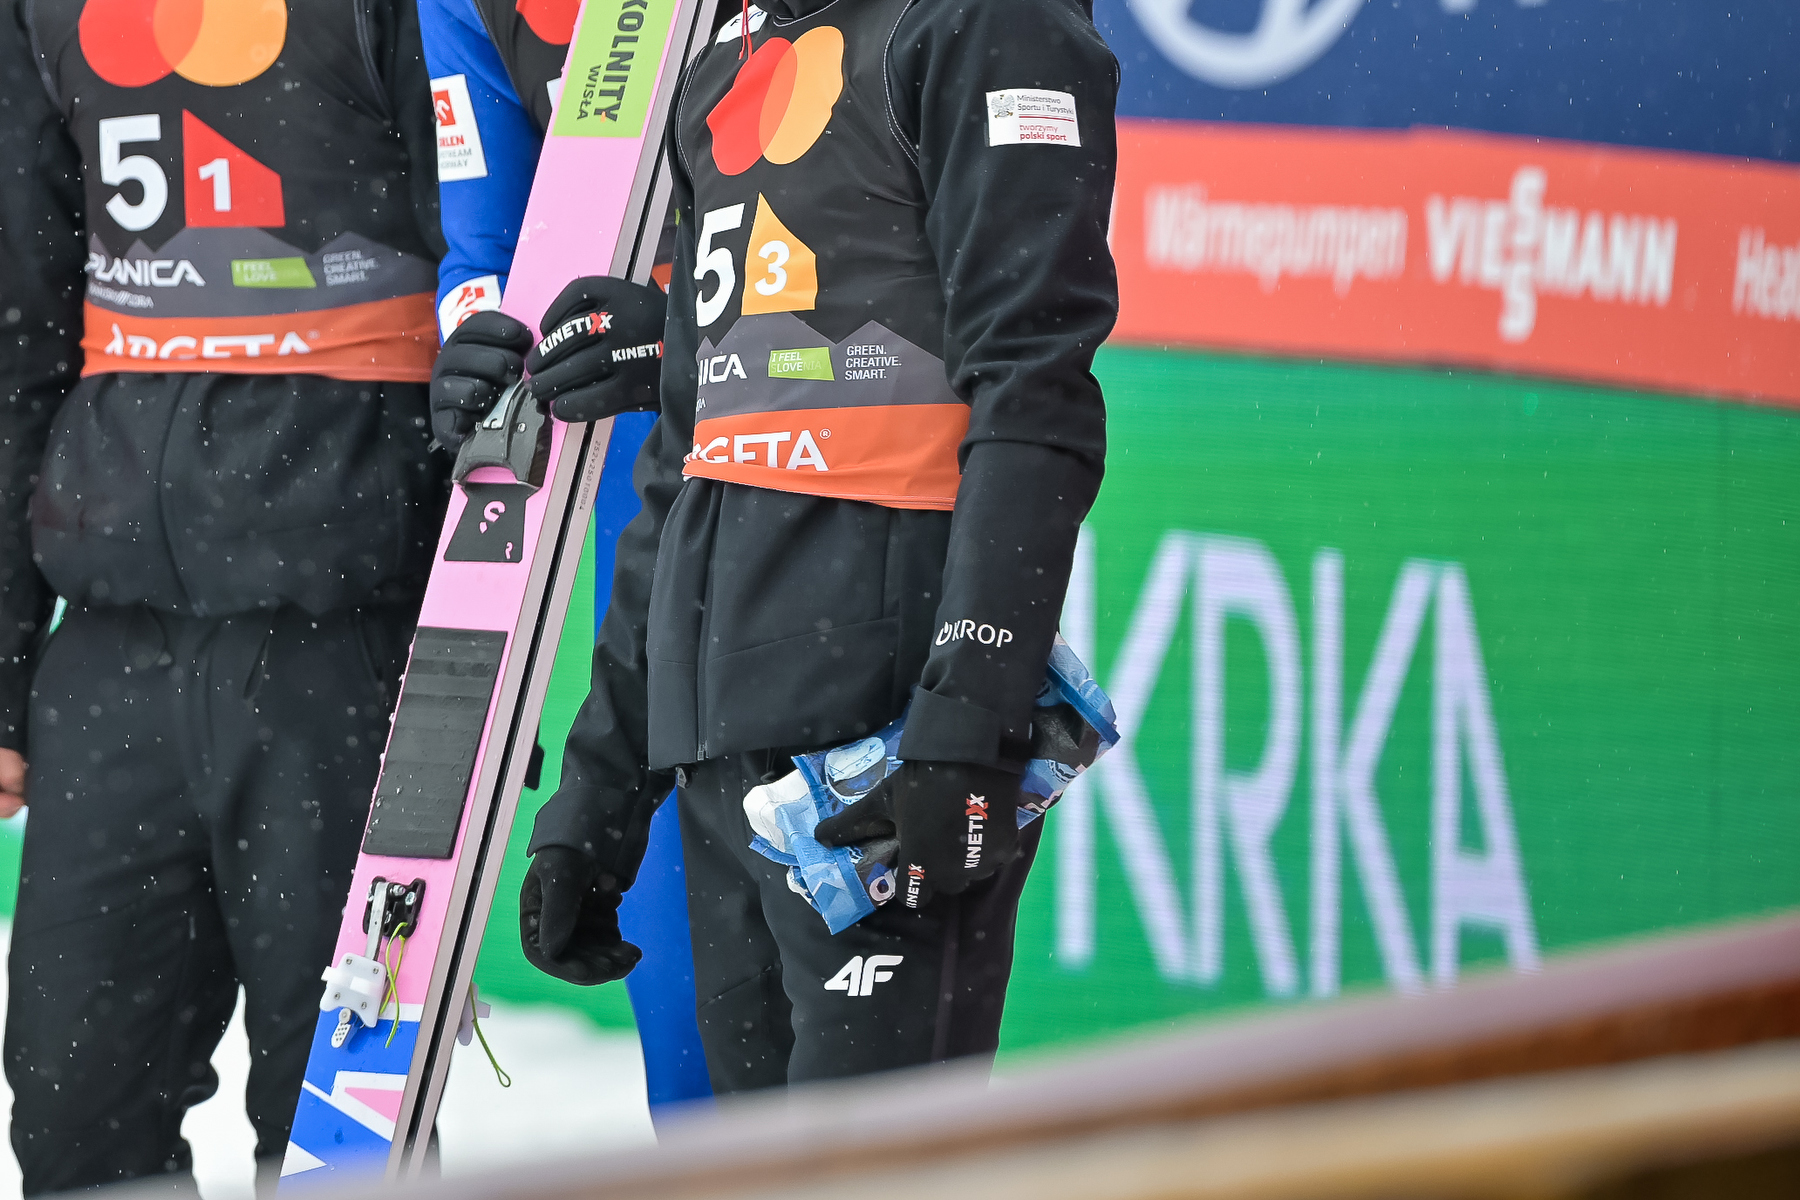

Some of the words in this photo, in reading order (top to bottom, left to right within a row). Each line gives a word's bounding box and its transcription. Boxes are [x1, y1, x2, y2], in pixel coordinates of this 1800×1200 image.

[576, 64, 602, 121] WISŁA
[1017, 95, 1061, 104] Ministerstwo
[1017, 104, 1041, 112] Sportu
[1020, 131, 1044, 141] polski
[1046, 133, 1067, 141] sport
[99, 114, 168, 231] 5
[198, 158, 232, 211] 1
[694, 203, 745, 327] 5
[754, 239, 790, 296] 3
[846, 344, 887, 356] GREEN.
[772, 352, 777, 362] I
[778, 351, 802, 361] FEEL
[845, 356, 902, 368] CREATIVE.
[844, 369, 887, 380] SMART.
[1054, 522, 1543, 998] KRKA
[824, 955, 903, 997] 4F
